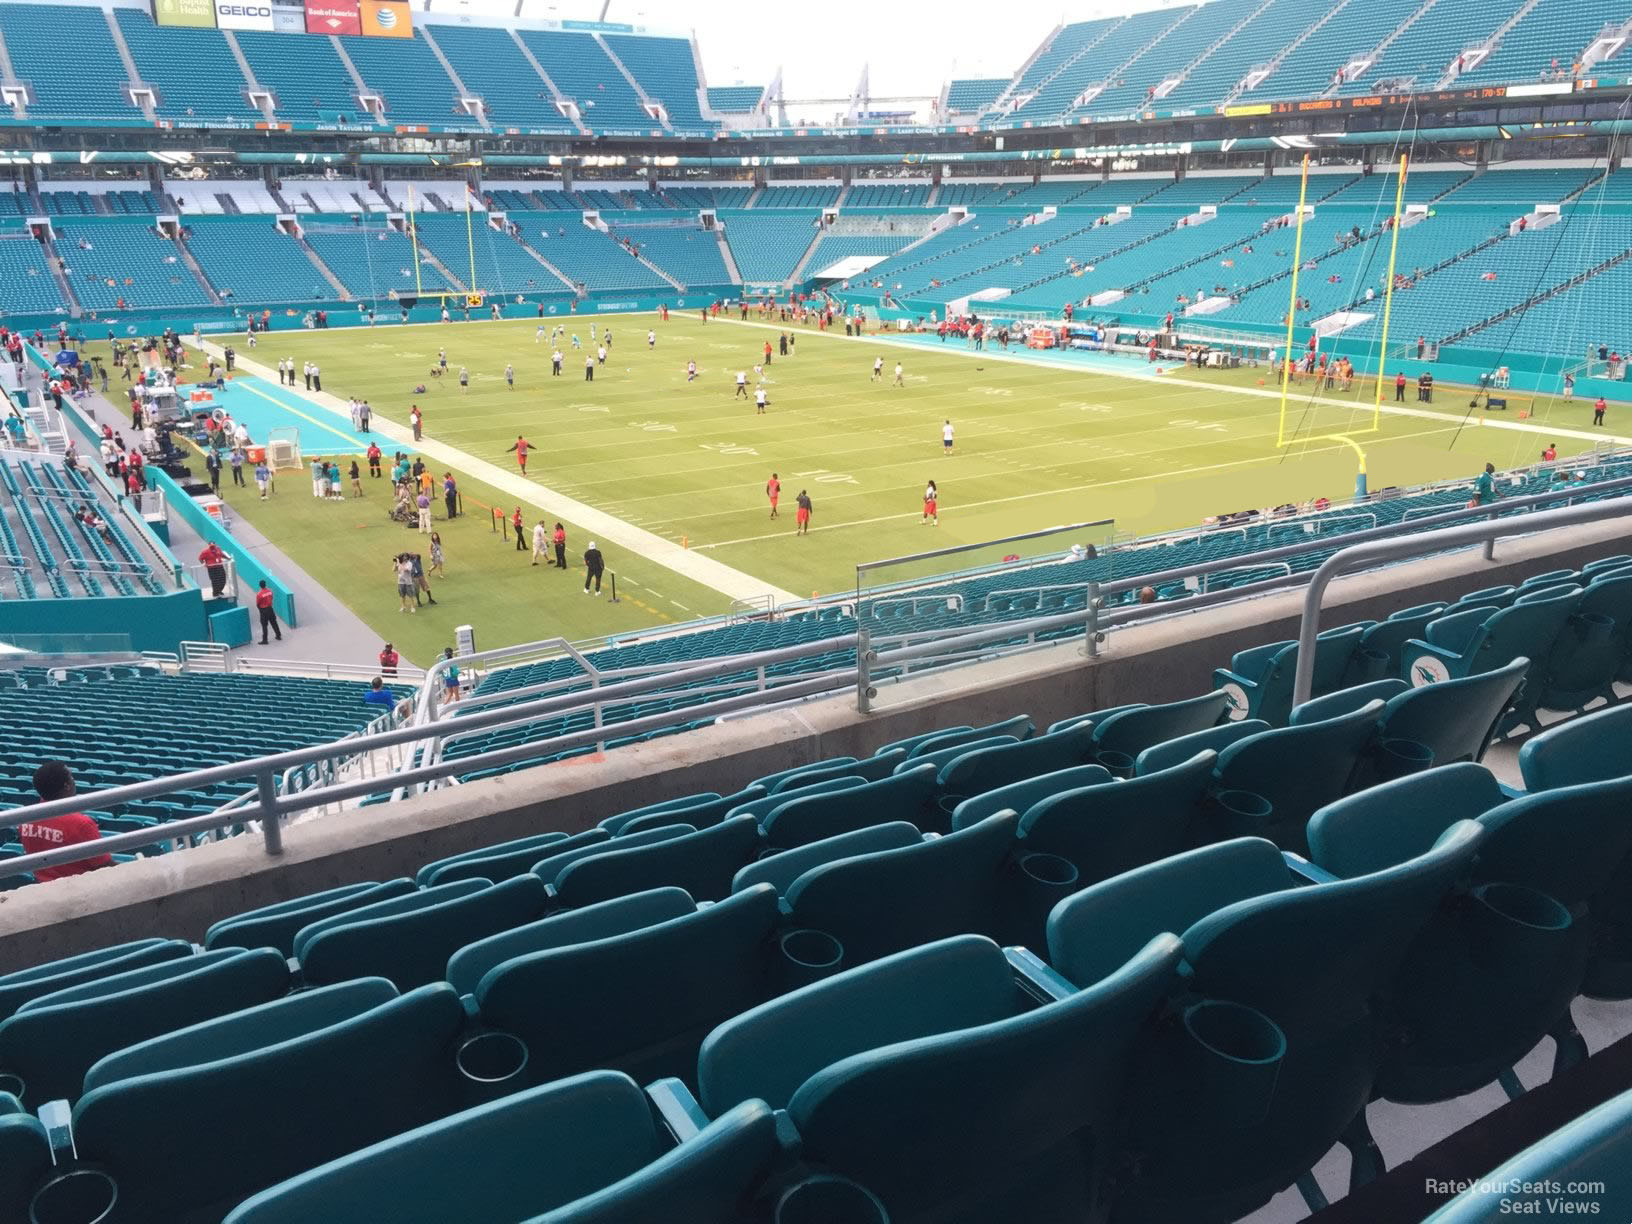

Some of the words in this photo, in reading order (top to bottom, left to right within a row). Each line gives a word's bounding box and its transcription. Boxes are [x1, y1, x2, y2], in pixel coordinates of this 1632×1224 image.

[180, 4, 209, 15] Health
[219, 5, 271, 17] GEICO
[332, 9, 358, 17] America
[468, 295, 481, 304] 25
[792, 469, 853, 483] 10
[21, 823, 64, 843] ELITE
